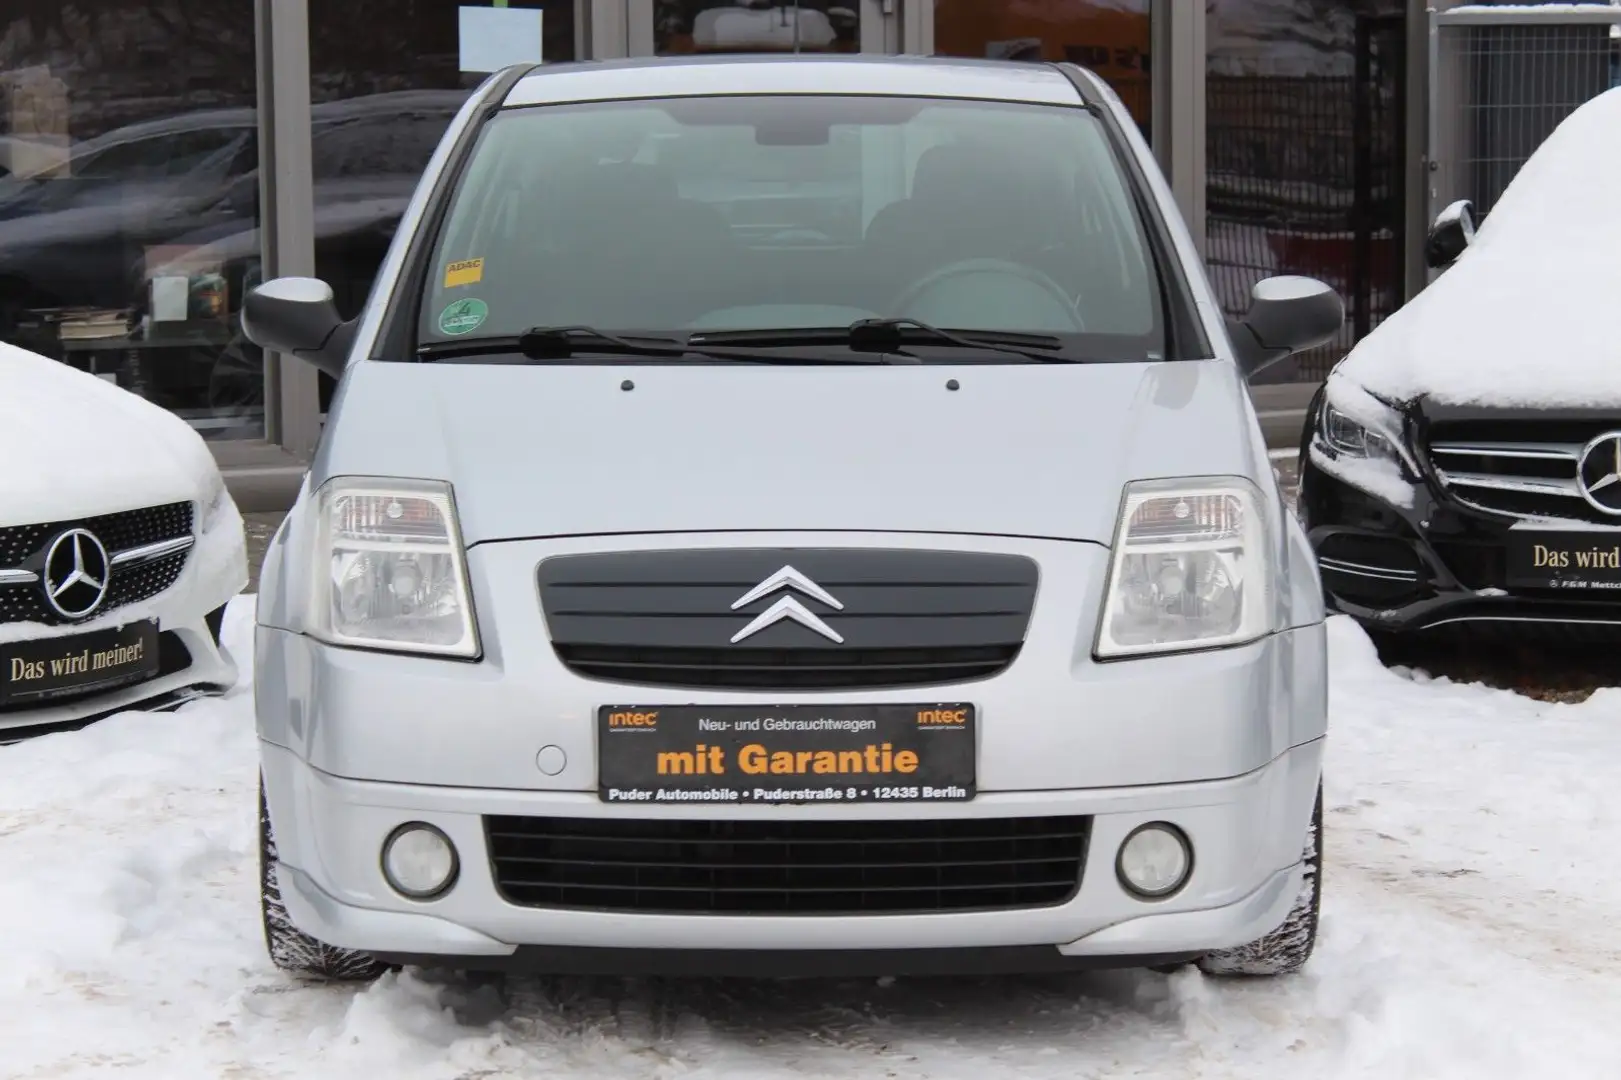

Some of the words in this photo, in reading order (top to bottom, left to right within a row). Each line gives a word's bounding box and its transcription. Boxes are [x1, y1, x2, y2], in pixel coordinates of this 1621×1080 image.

[448, 260, 482, 272] ADAC
[1533, 545, 1569, 568] Das
[1575, 547, 1621, 568] wird
[10, 657, 45, 681] Das
[51, 649, 88, 676] wird
[92, 637, 144, 670] meiner!
[608, 711, 659, 726] intec
[917, 708, 967, 724] intec
[698, 718, 732, 731] Neu-
[734, 718, 760, 731] und
[762, 718, 876, 732] Gebrauchtwagen
[657, 744, 725, 774] mit
[738, 743, 919, 774] Garantie
[608, 788, 652, 800] Puder
[655, 788, 738, 800] Automobile
[753, 787, 843, 800] Puderstraße
[846, 788, 857, 799] 8
[872, 786, 919, 799] 12435
[922, 786, 966, 798] Berlin
